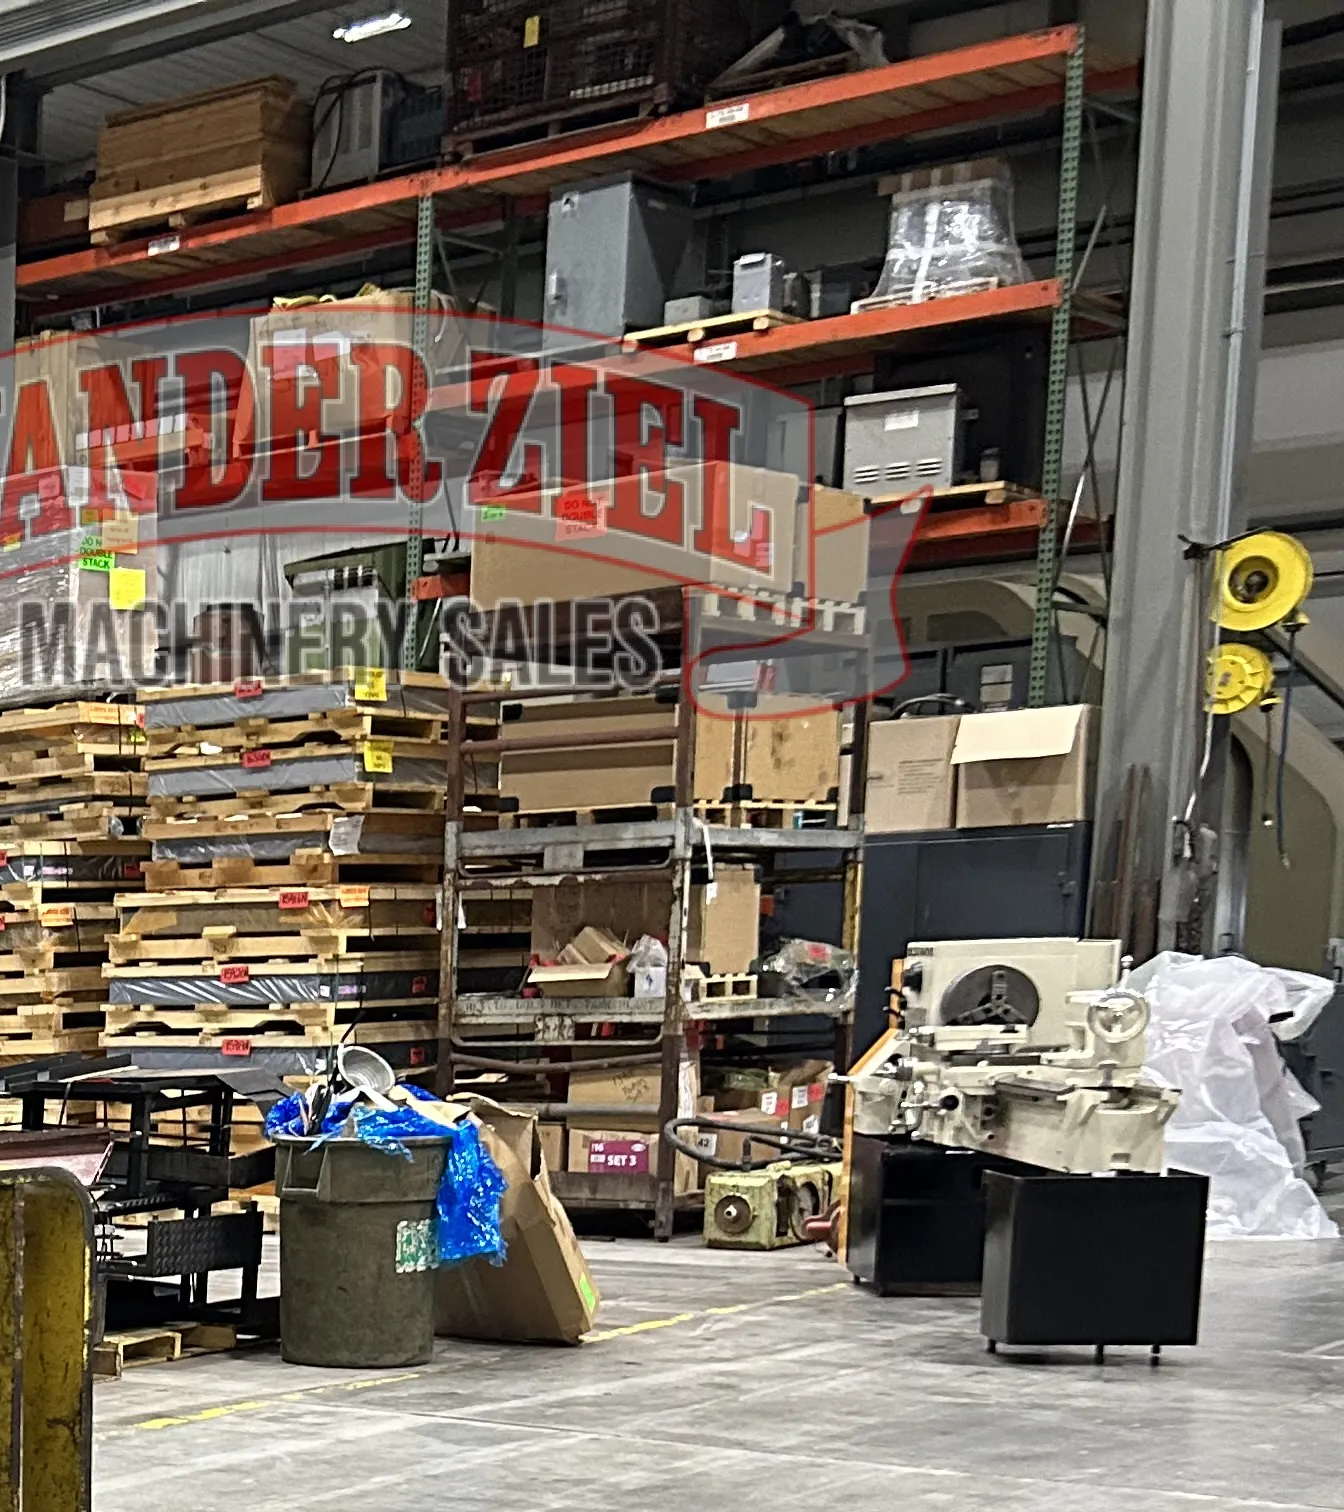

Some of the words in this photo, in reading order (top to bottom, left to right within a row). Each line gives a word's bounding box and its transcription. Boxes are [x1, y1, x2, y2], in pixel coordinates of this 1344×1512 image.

[82, 557, 111, 569] STACK
[607, 1154, 628, 1167] SET
[629, 1154, 637, 1167] 3
